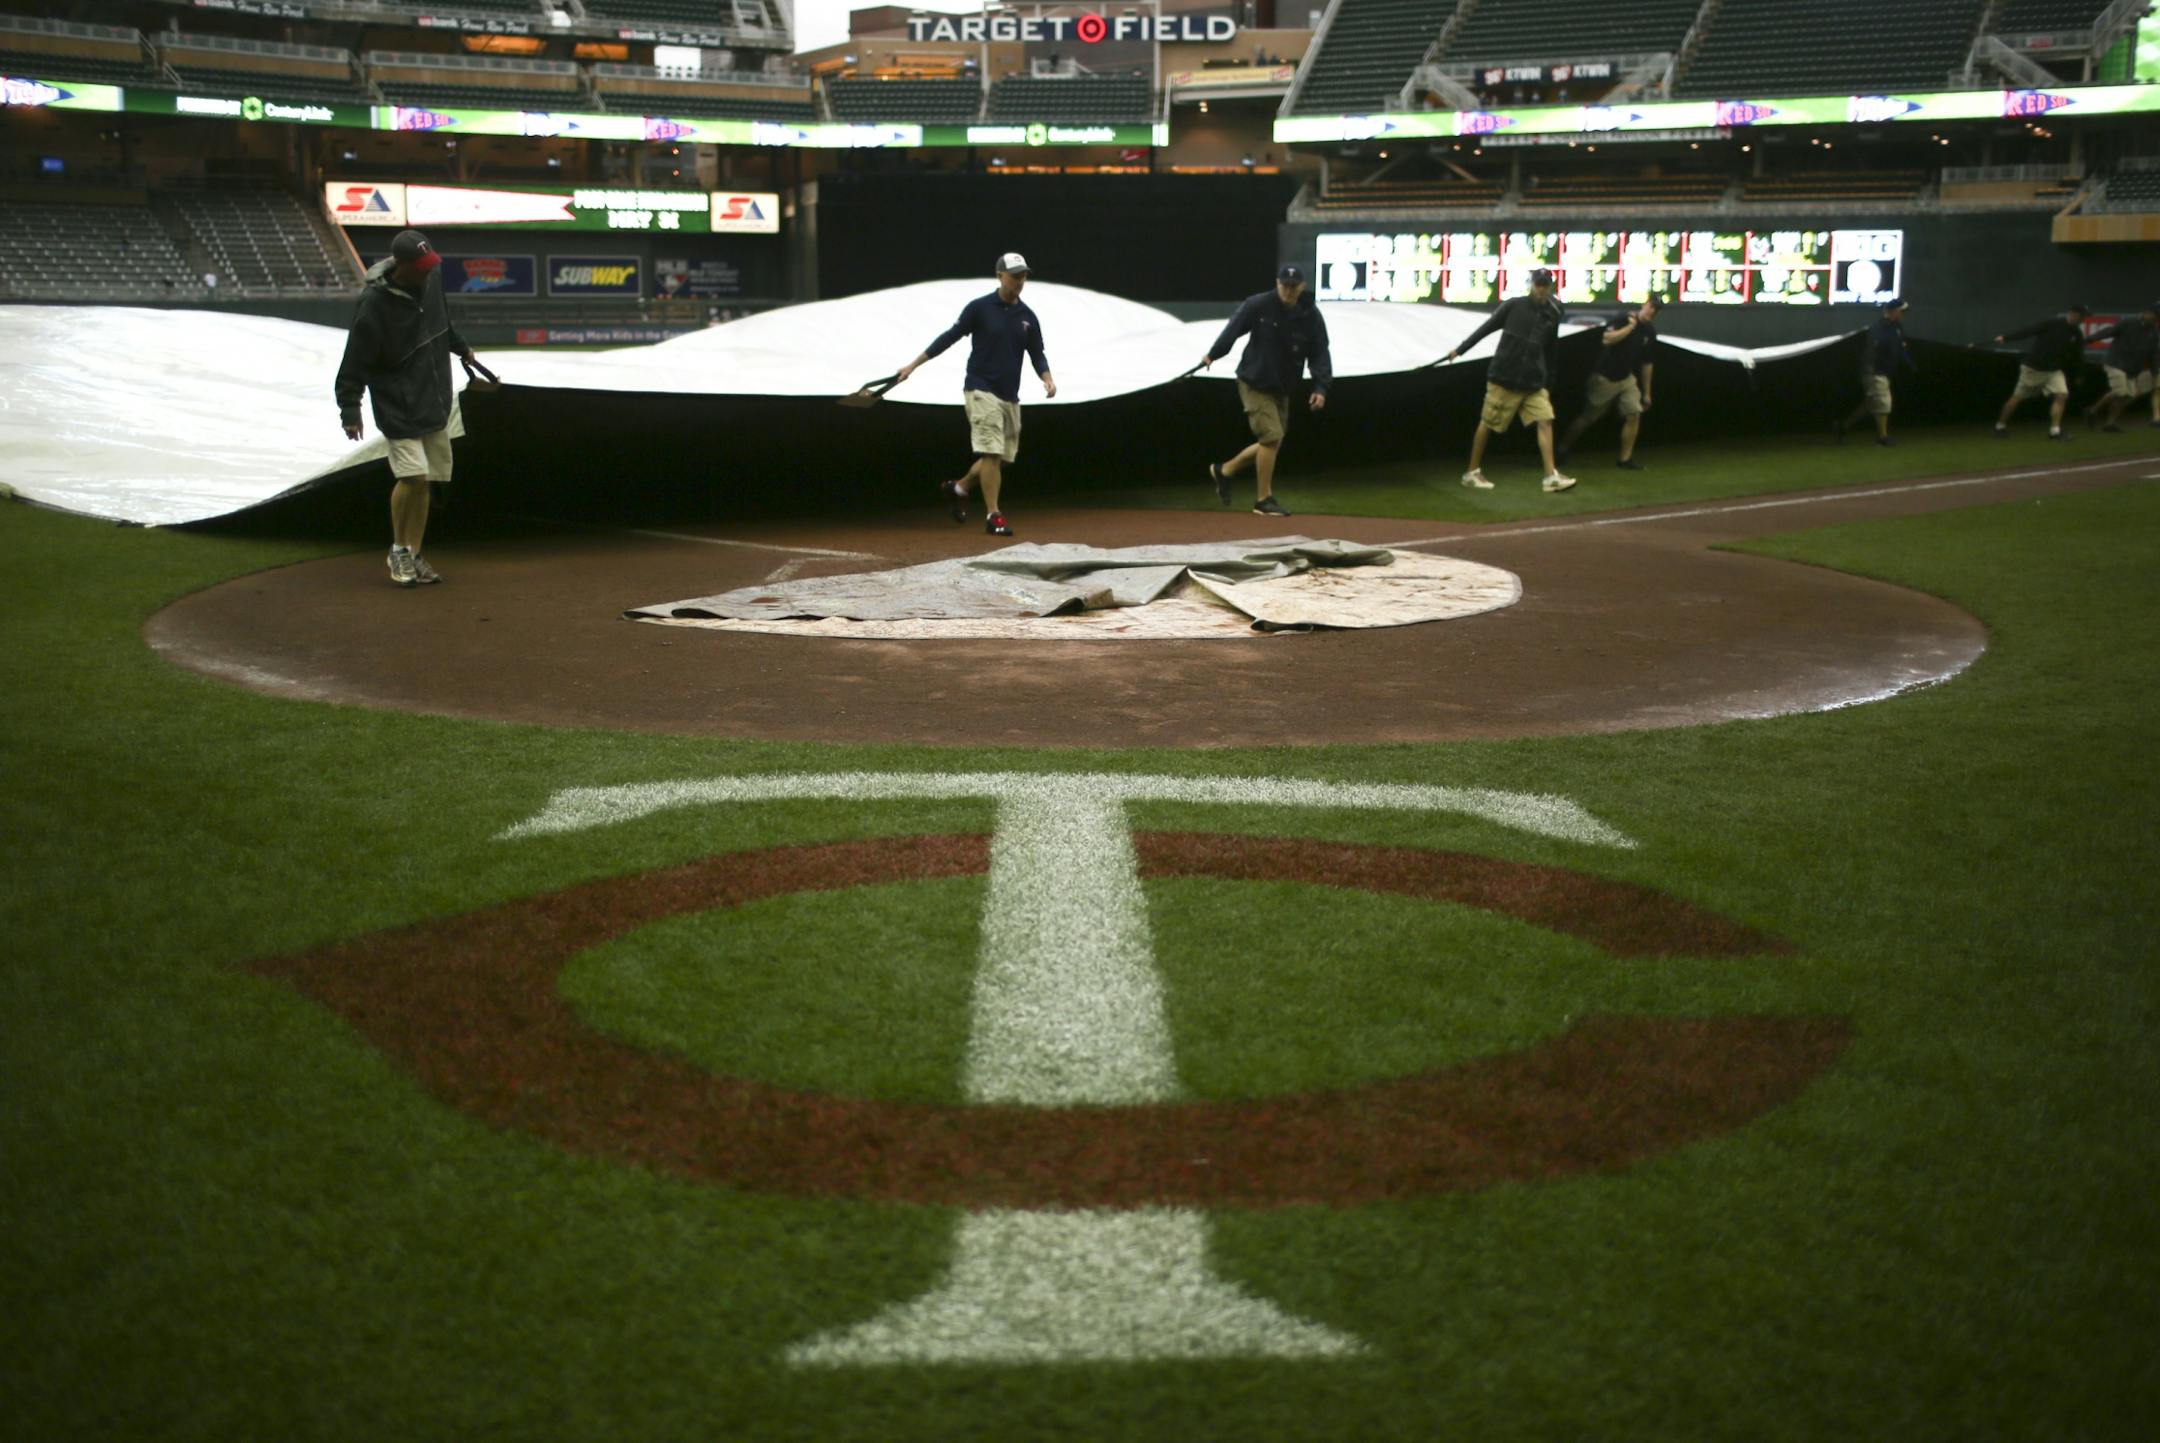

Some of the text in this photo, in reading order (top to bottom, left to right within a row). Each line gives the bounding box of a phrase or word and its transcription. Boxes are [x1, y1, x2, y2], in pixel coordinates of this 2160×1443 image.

[907, 16, 1236, 41] TARGET FIELD
[2005, 91, 2046, 116] RED
[554, 265, 636, 286] SUBWAY
